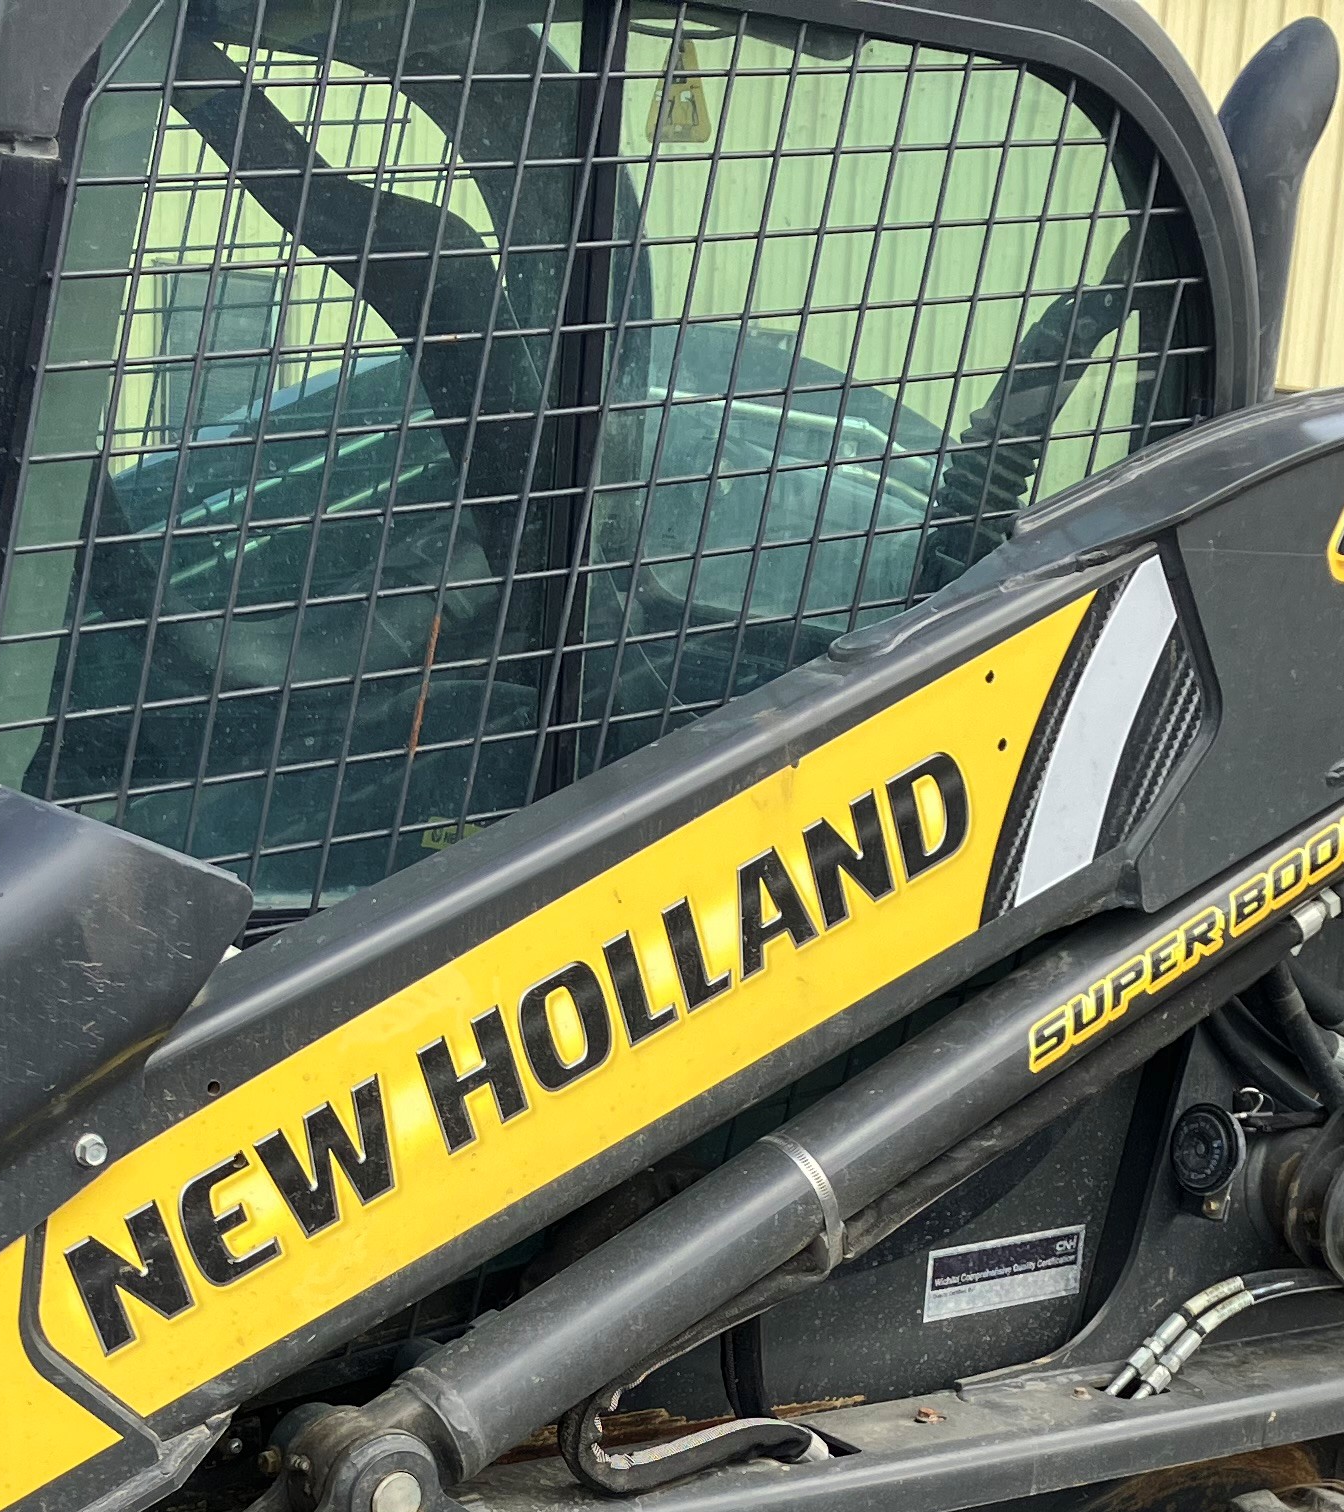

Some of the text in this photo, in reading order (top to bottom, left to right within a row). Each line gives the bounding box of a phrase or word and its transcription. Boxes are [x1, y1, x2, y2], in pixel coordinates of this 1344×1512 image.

[63, 751, 970, 1356] NEW HOLLAND
[1029, 905, 1226, 1073] SUPER
[1013, 1261, 1036, 1273] Quality
[1037, 1254, 1077, 1268] Certification
